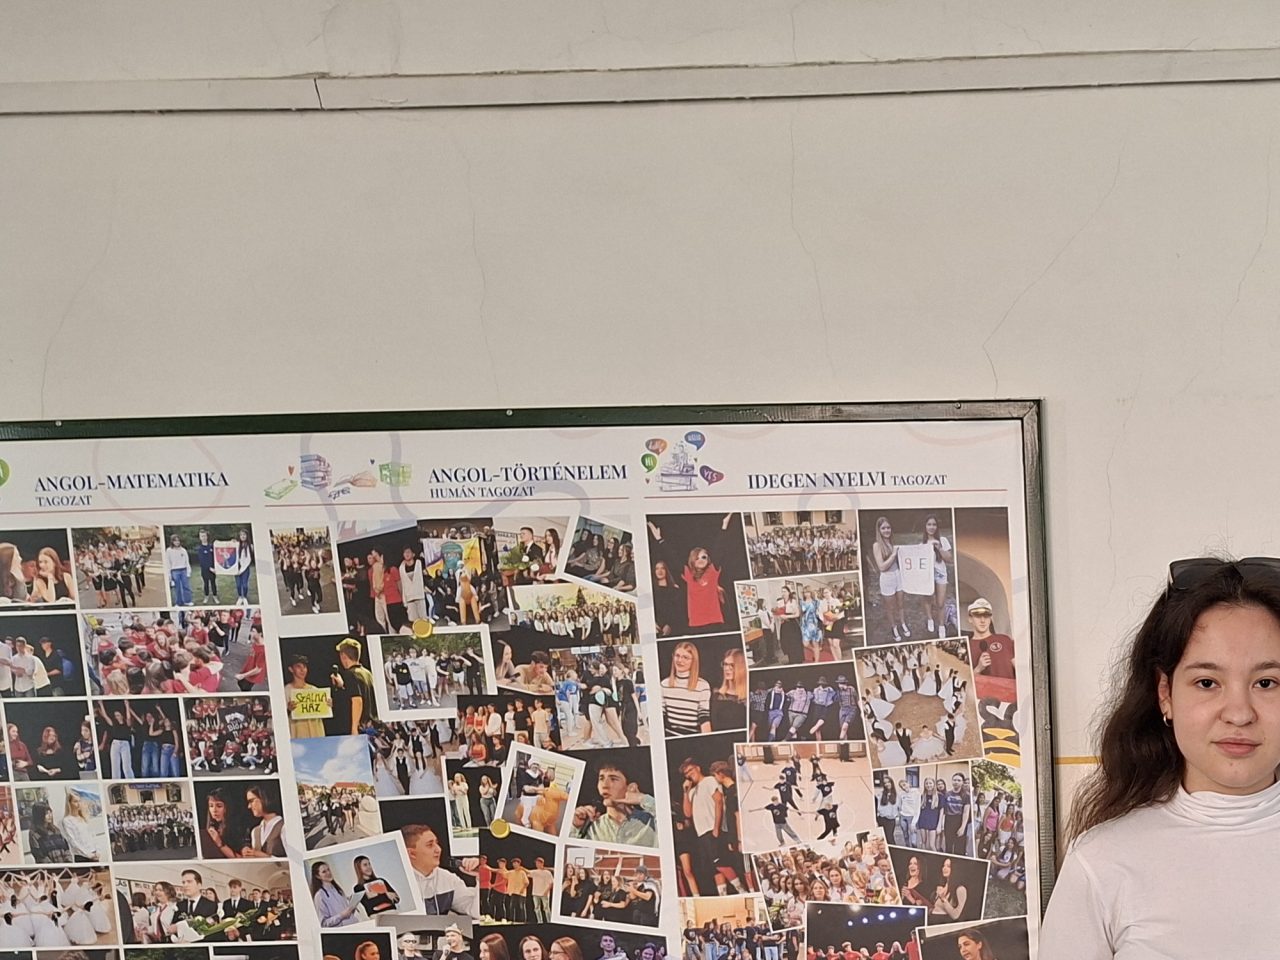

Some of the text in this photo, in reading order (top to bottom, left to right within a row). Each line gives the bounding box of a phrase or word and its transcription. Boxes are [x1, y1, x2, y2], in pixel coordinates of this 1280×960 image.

[34, 471, 230, 493] ANGOL-MATEMATIKA
[428, 462, 628, 484] ANGOL-TÖRTÉNELEM
[747, 471, 948, 490] IDEGEN NYELVI TAGOZAT
[35, 494, 93, 507] TAGOZAT
[429, 485, 536, 499] HUMÁN TAGOZAT
